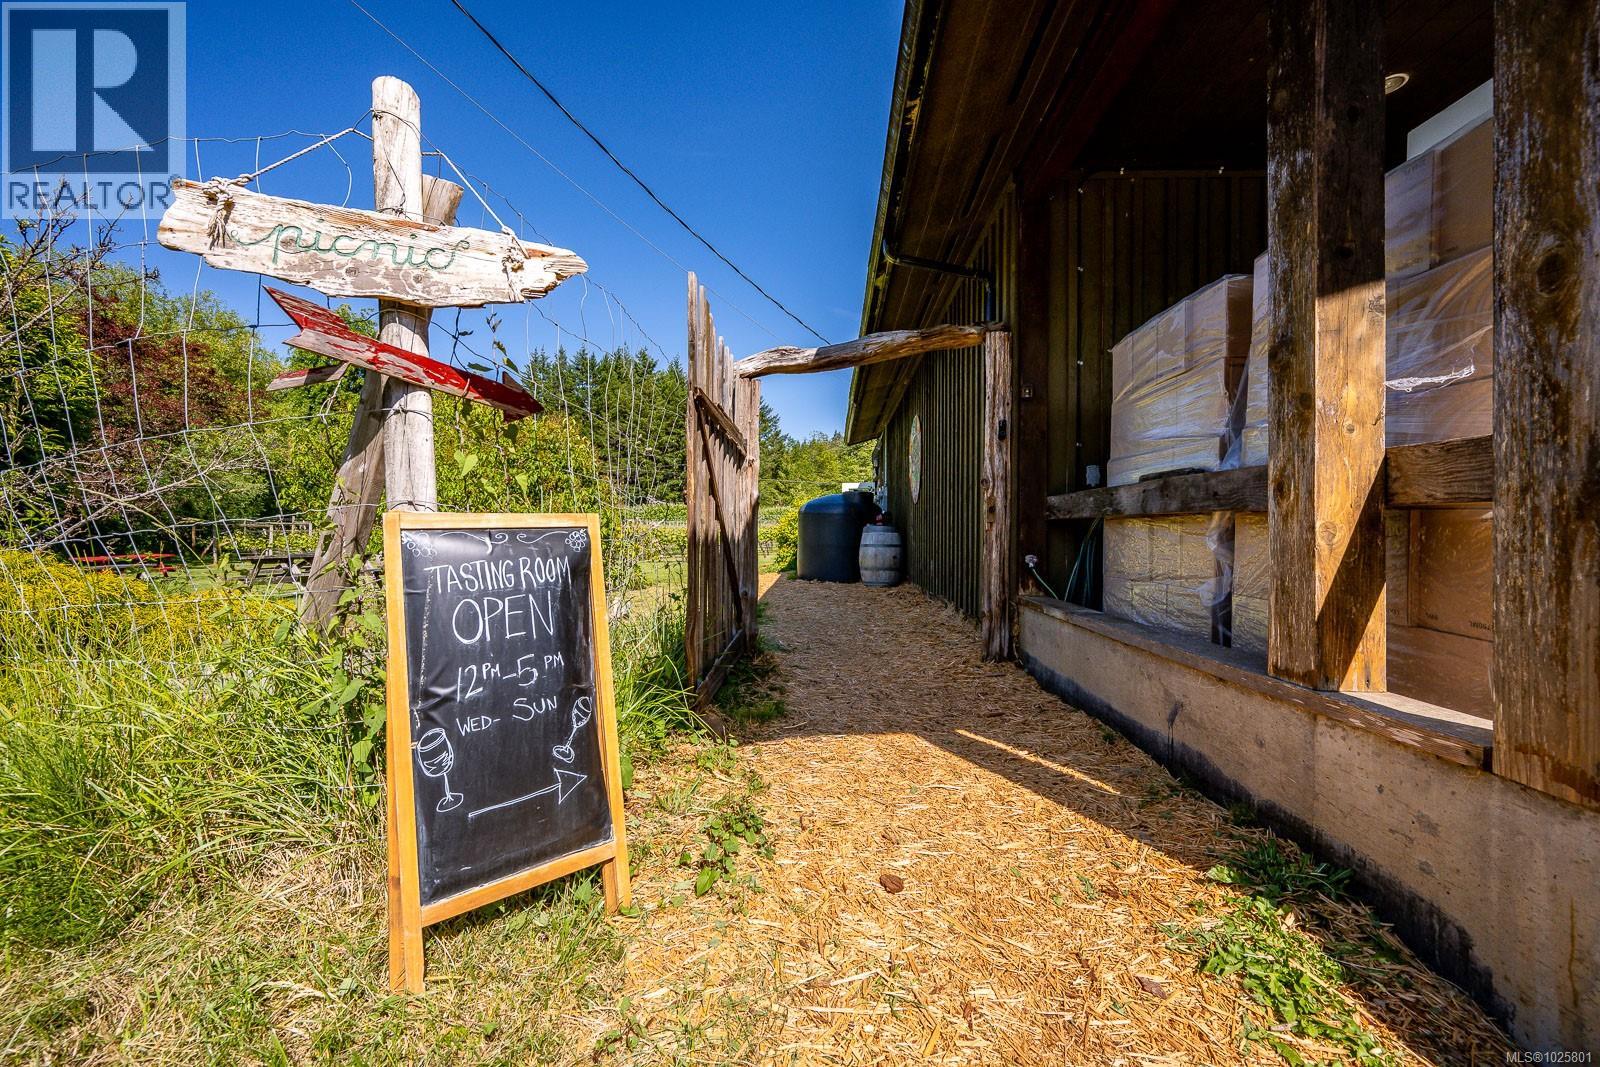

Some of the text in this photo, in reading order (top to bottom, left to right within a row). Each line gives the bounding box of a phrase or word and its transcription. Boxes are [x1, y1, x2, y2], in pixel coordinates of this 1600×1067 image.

[229, 218, 470, 270] picnic
[424, 556, 571, 594] TASTING ROOM
[452, 591, 553, 644] OPEN
